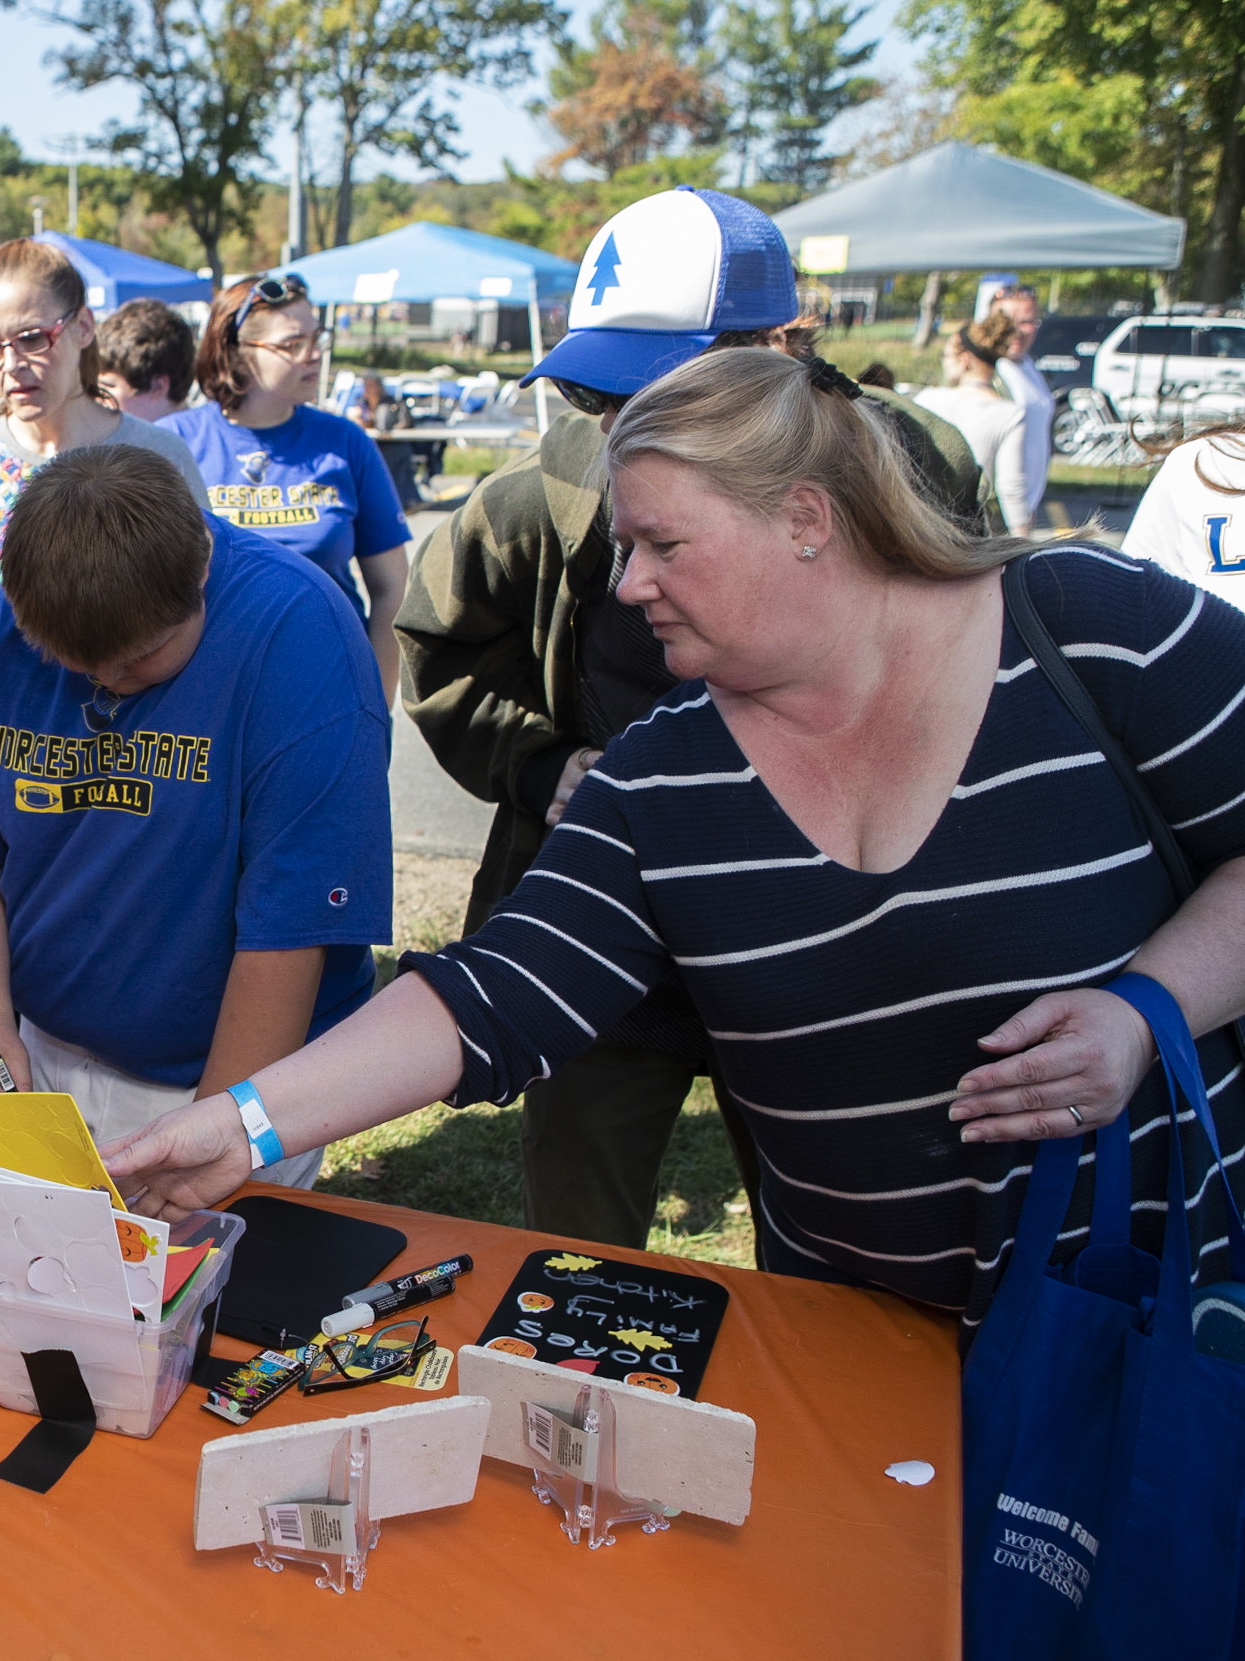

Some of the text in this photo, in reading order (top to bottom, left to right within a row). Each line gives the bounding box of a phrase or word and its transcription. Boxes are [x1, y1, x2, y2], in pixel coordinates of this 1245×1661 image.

[243, 508, 313, 524] FOOTBALL
[414, 1261, 461, 1285] DecoColor
[996, 1492, 1070, 1532] Welcome
